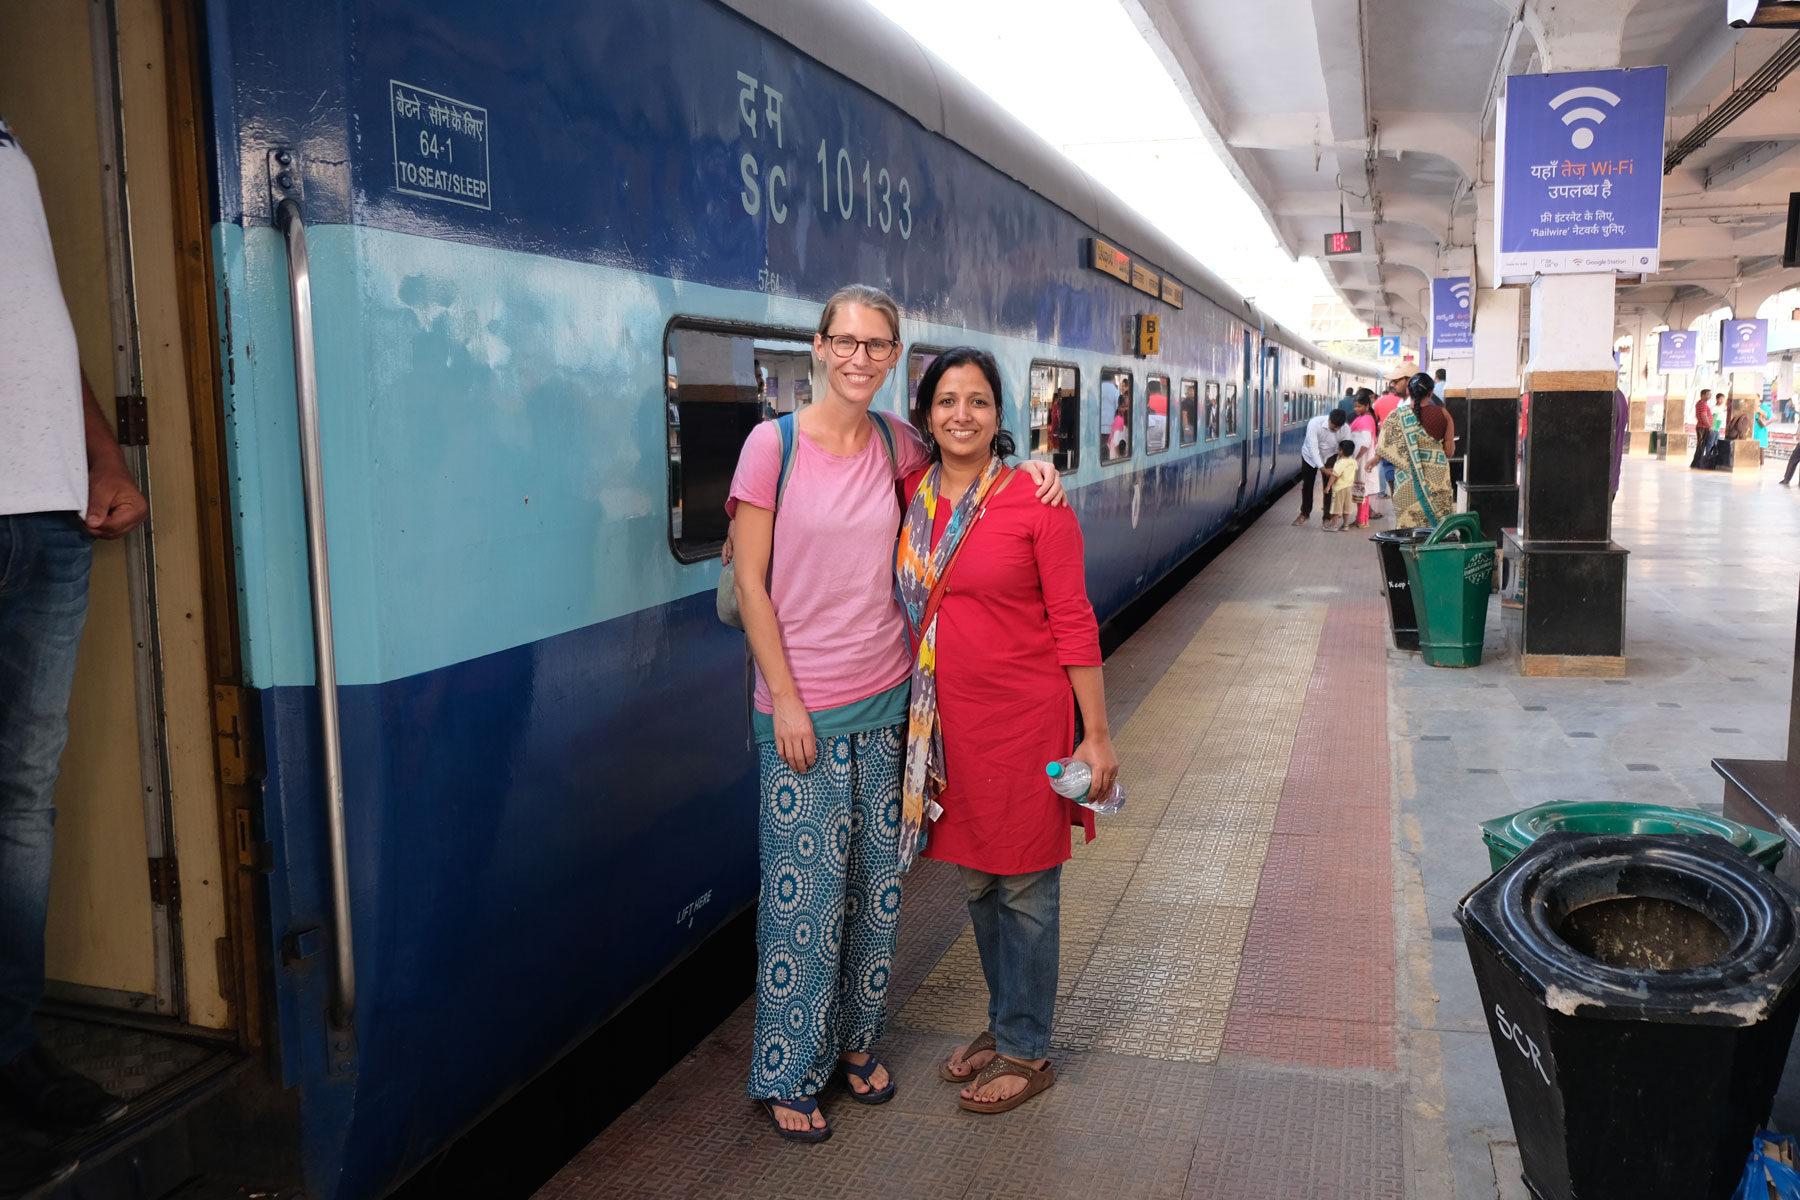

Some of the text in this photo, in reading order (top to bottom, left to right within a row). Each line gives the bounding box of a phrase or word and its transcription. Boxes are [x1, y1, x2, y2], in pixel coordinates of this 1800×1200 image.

[452, 106, 462, 132] के
[463, 111, 484, 142] लिए
[399, 161, 487, 199] TO SEAT/SLEEP
[1531, 160, 1633, 180] यहाँ तेज़ Wi-Fi
[740, 138, 912, 240] SC 10133
[1548, 179, 1613, 199] उपलब्ध है
[1584, 210, 1593, 222] के
[1572, 224, 1599, 236] नेटवर्क
[1585, 255, 1627, 266] Google Station
[1146, 320, 1156, 334] B
[1146, 336, 1154, 351] 1
[1383, 339, 1395, 356] 2
[676, 889, 713, 925] LIFT HERE
[1495, 1004, 1551, 1087] SCR
